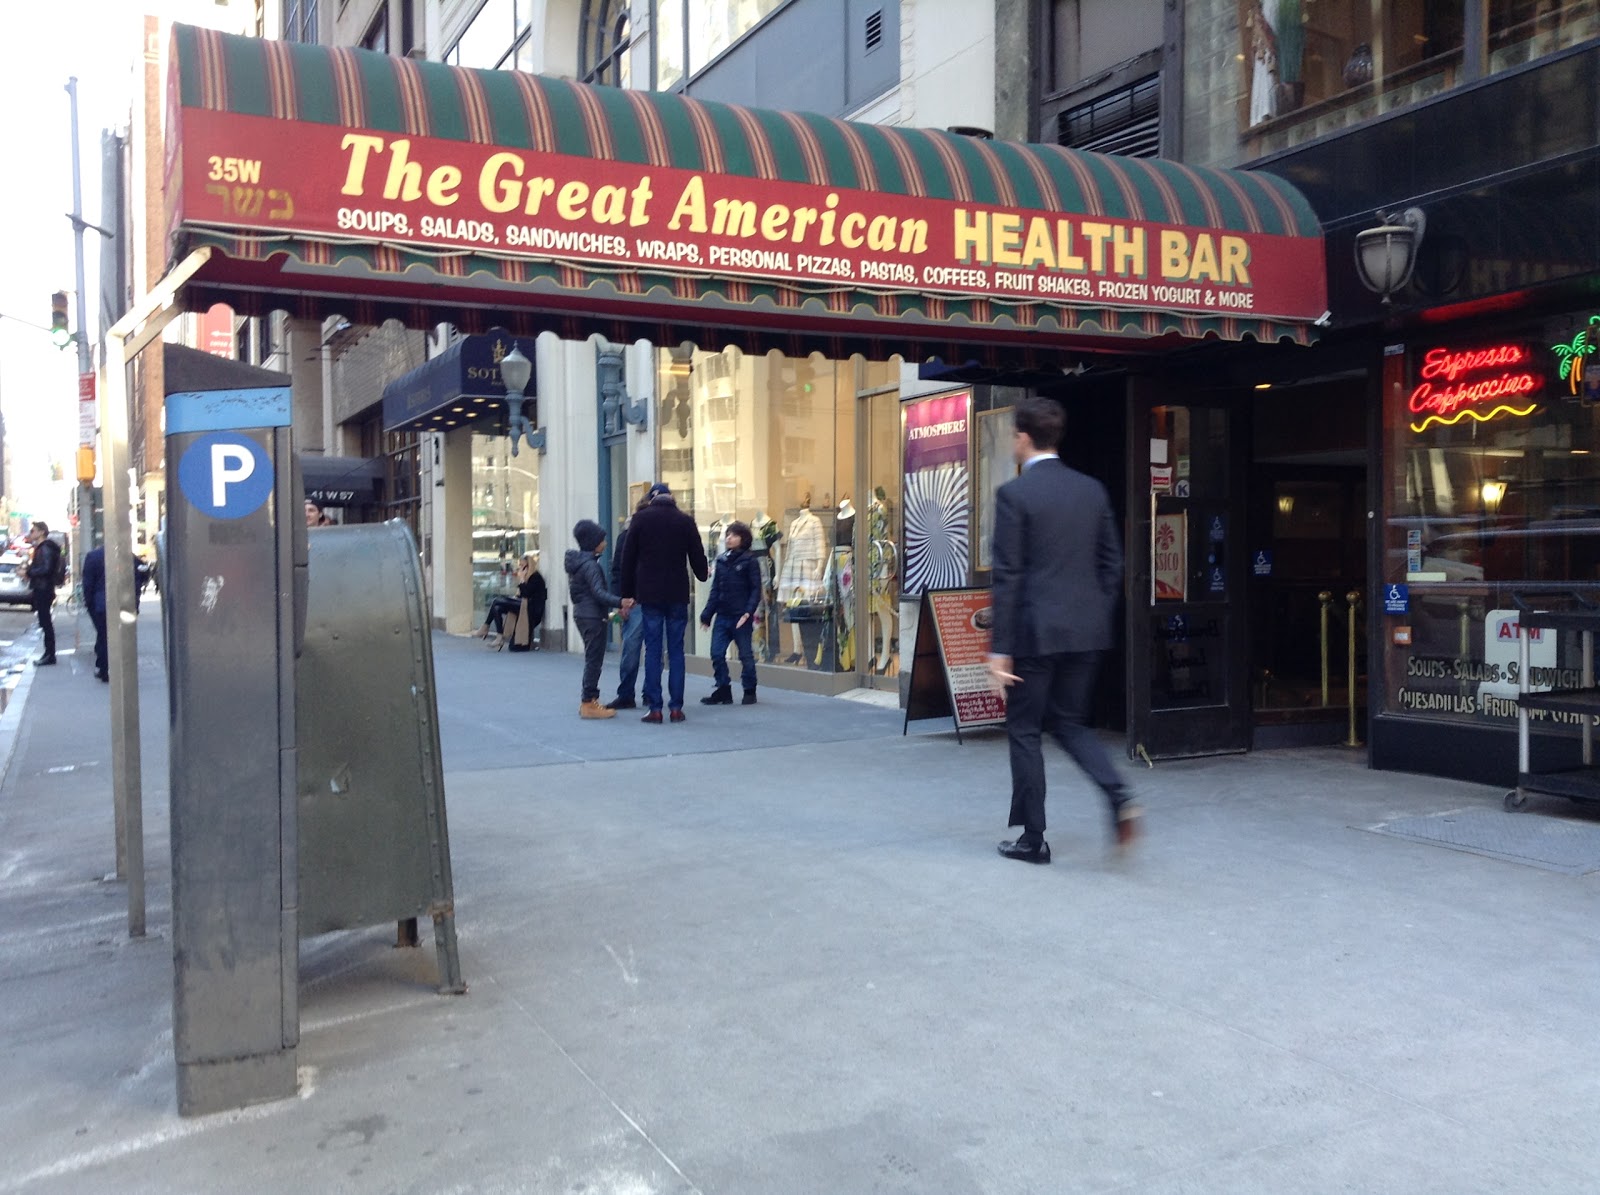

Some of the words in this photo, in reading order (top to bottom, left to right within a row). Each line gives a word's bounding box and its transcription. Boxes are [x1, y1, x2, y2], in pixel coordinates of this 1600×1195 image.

[208, 156, 262, 184] 35W
[206, 184, 294, 220] כשר
[340, 133, 462, 206] The
[479, 152, 653, 227] Great
[667, 175, 928, 254] American
[954, 208, 1146, 278] HEALTH
[1160, 229, 1252, 286] BAR
[337, 208, 414, 237] SOUPS,
[421, 216, 499, 246] SALADS,
[506, 225, 631, 258] SANDWICHES,
[636, 239, 704, 267] WRAPS,
[709, 246, 792, 271] PERSONAL
[797, 253, 855, 280] PIZZAS,
[860, 260, 919, 285] PASTAS,
[923, 266, 990, 290] COFFEES,
[995, 271, 1034, 291] FRUIT
[1038, 275, 1094, 298] SHAKES,
[1099, 281, 1148, 301] FROZEN
[1151, 285, 1201, 305] YOGURT
[1204, 290, 1215, 306] &
[1218, 291, 1254, 309] MORE
[1420, 345, 1523, 381] Espresso
[1408, 373, 1534, 415] Cappuccino
[908, 420, 966, 441] ATMOSPHERE
[211, 444, 255, 507] P
[326, 491, 338, 500] W
